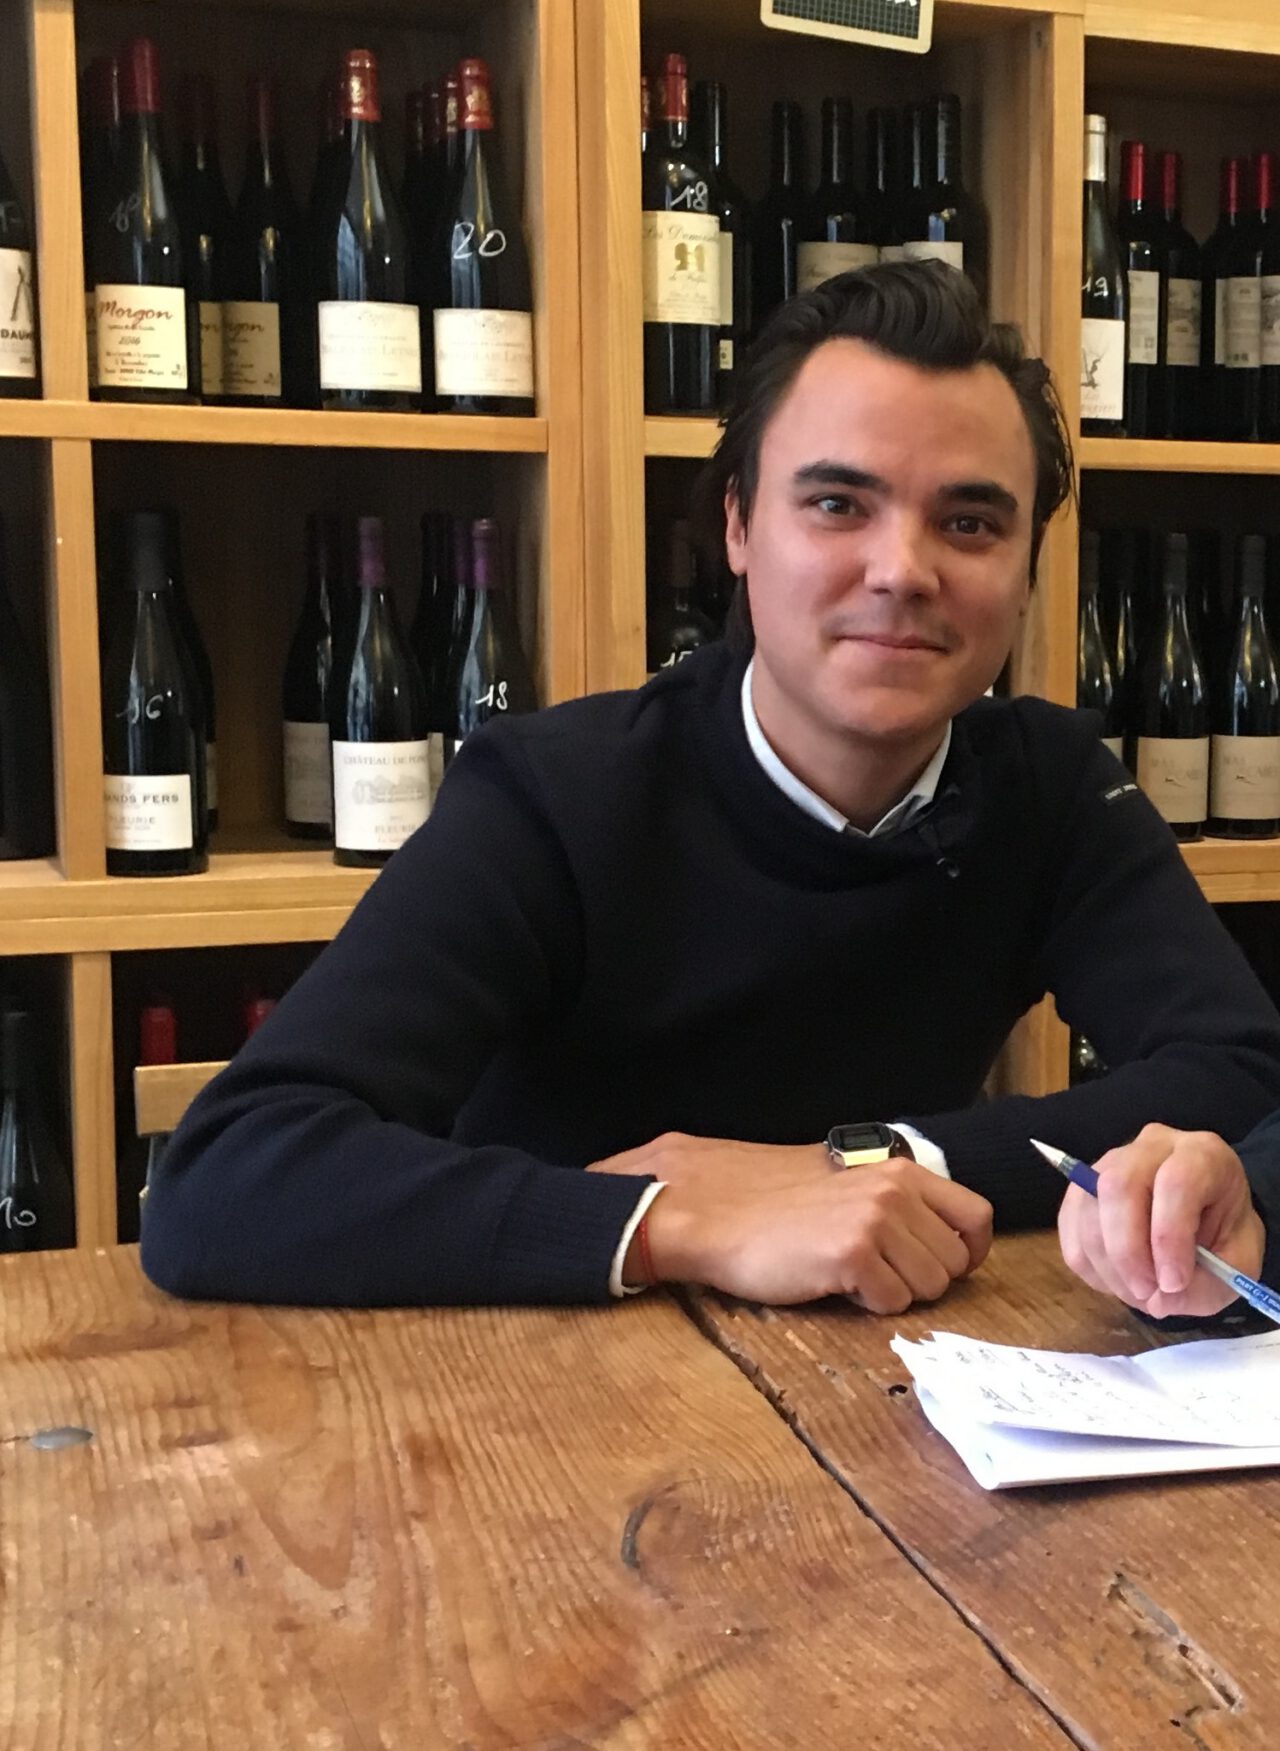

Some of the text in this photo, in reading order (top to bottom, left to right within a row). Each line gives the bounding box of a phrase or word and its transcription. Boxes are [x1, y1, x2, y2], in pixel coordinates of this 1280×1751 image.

[669, 180, 708, 211] 18
[452, 220, 507, 259] 20
[100, 300, 173, 328] Morgon
[115, 694, 164, 725] 16
[475, 681, 508, 711] 18
[142, 792, 179, 805] FERS
